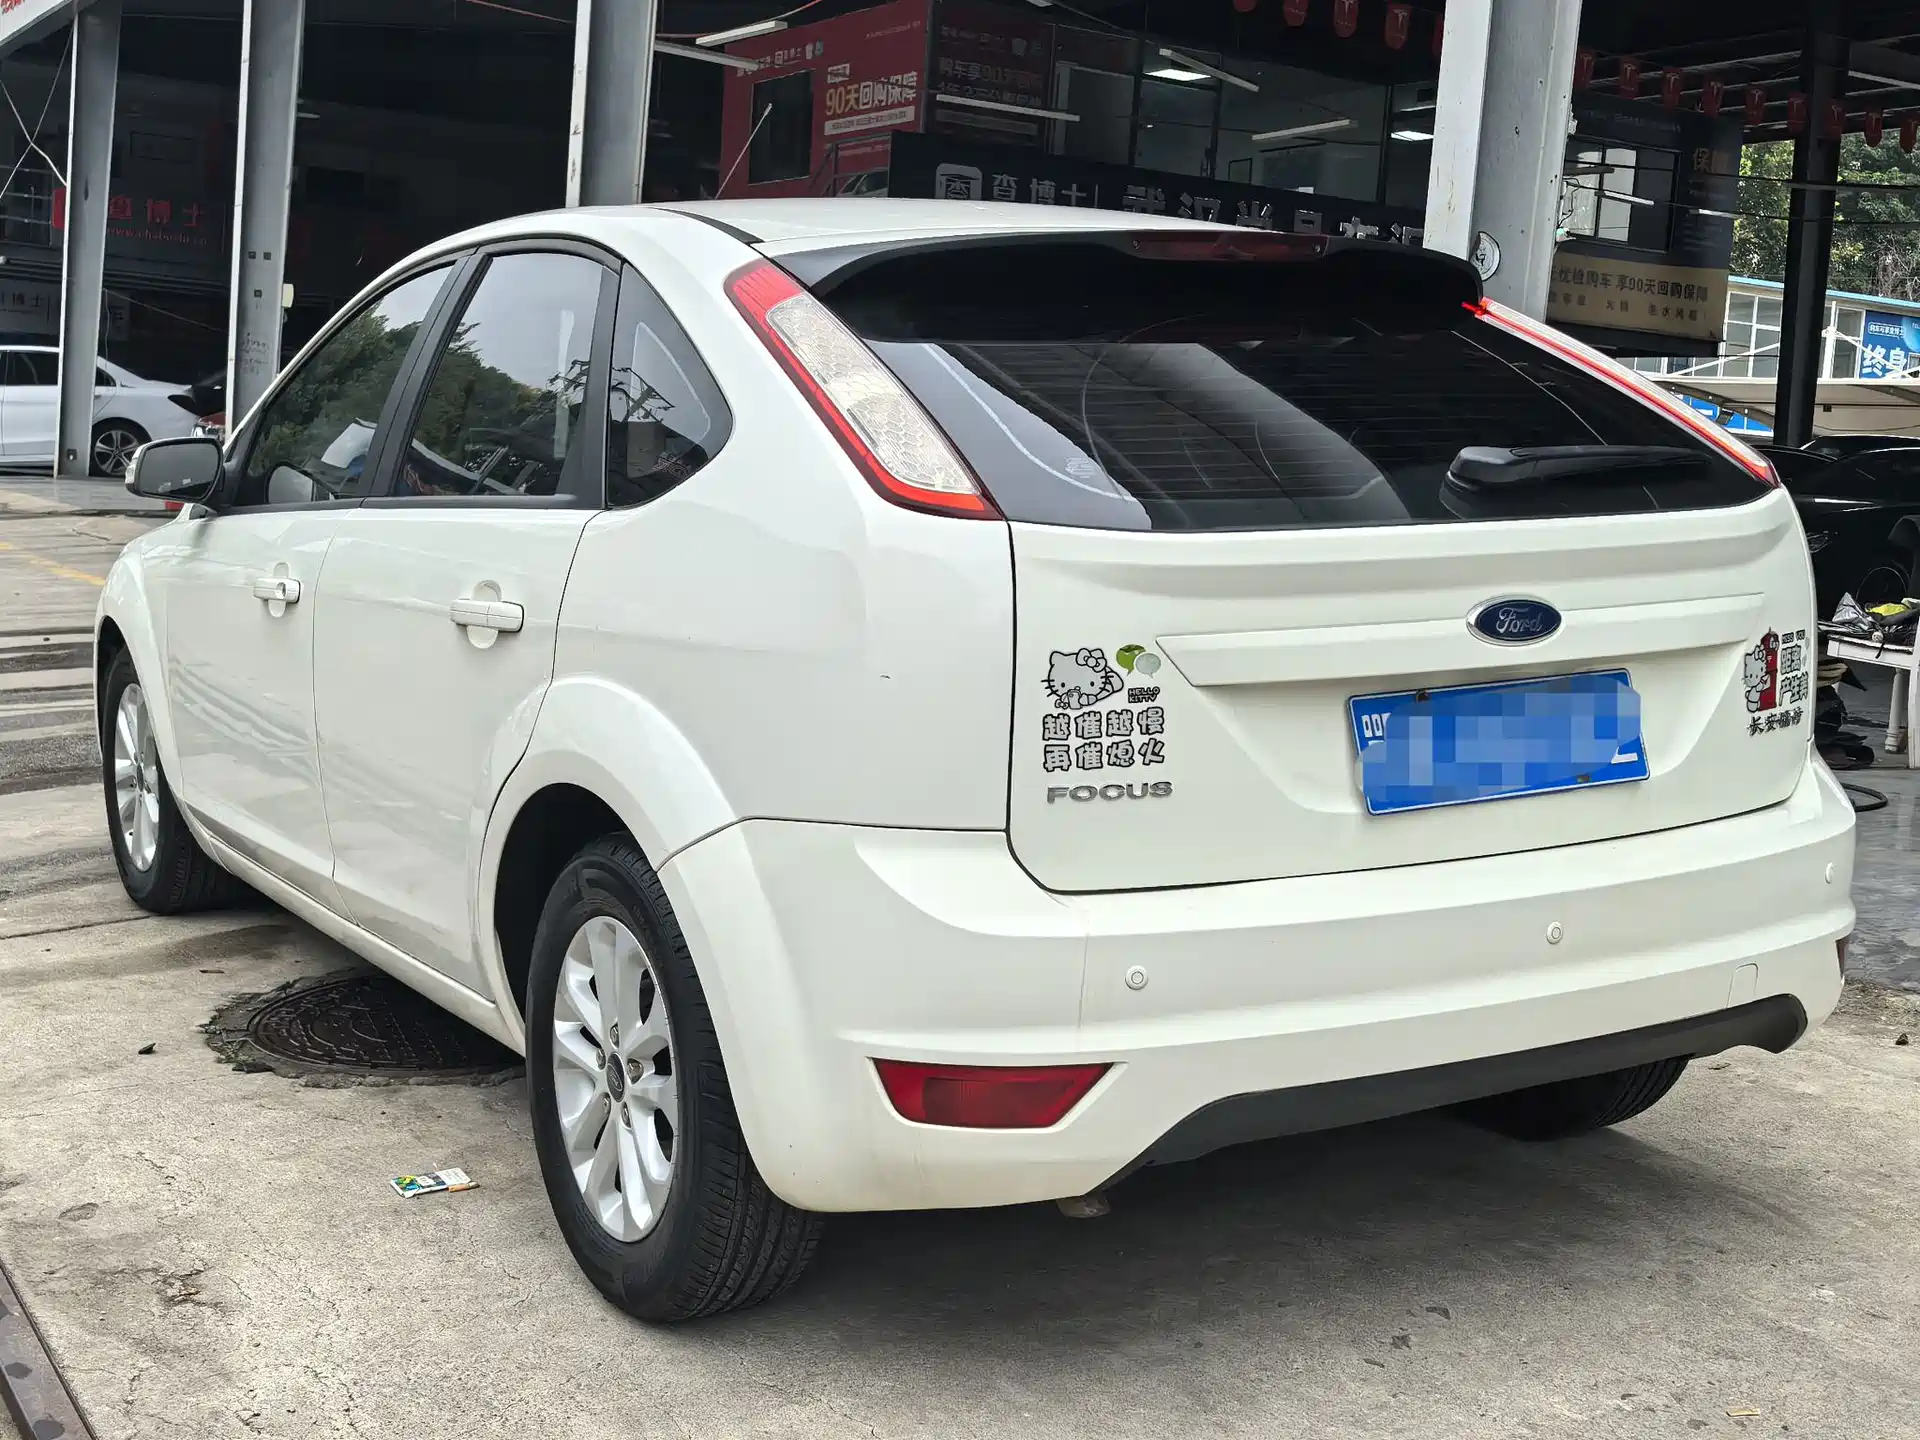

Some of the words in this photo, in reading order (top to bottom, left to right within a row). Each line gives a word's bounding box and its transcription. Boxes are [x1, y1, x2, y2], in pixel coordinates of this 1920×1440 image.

[825, 70, 917, 116] 90天回购保障
[1862, 343, 1908, 377] 终身
[1495, 607, 1544, 633] Ford
[1128, 686, 1160, 696] HELLO
[1128, 694, 1159, 703] KITTY
[1042, 706, 1165, 741] 越催越慢
[1043, 738, 1165, 772] 再催熄火
[1046, 781, 1173, 804] FOCUS
